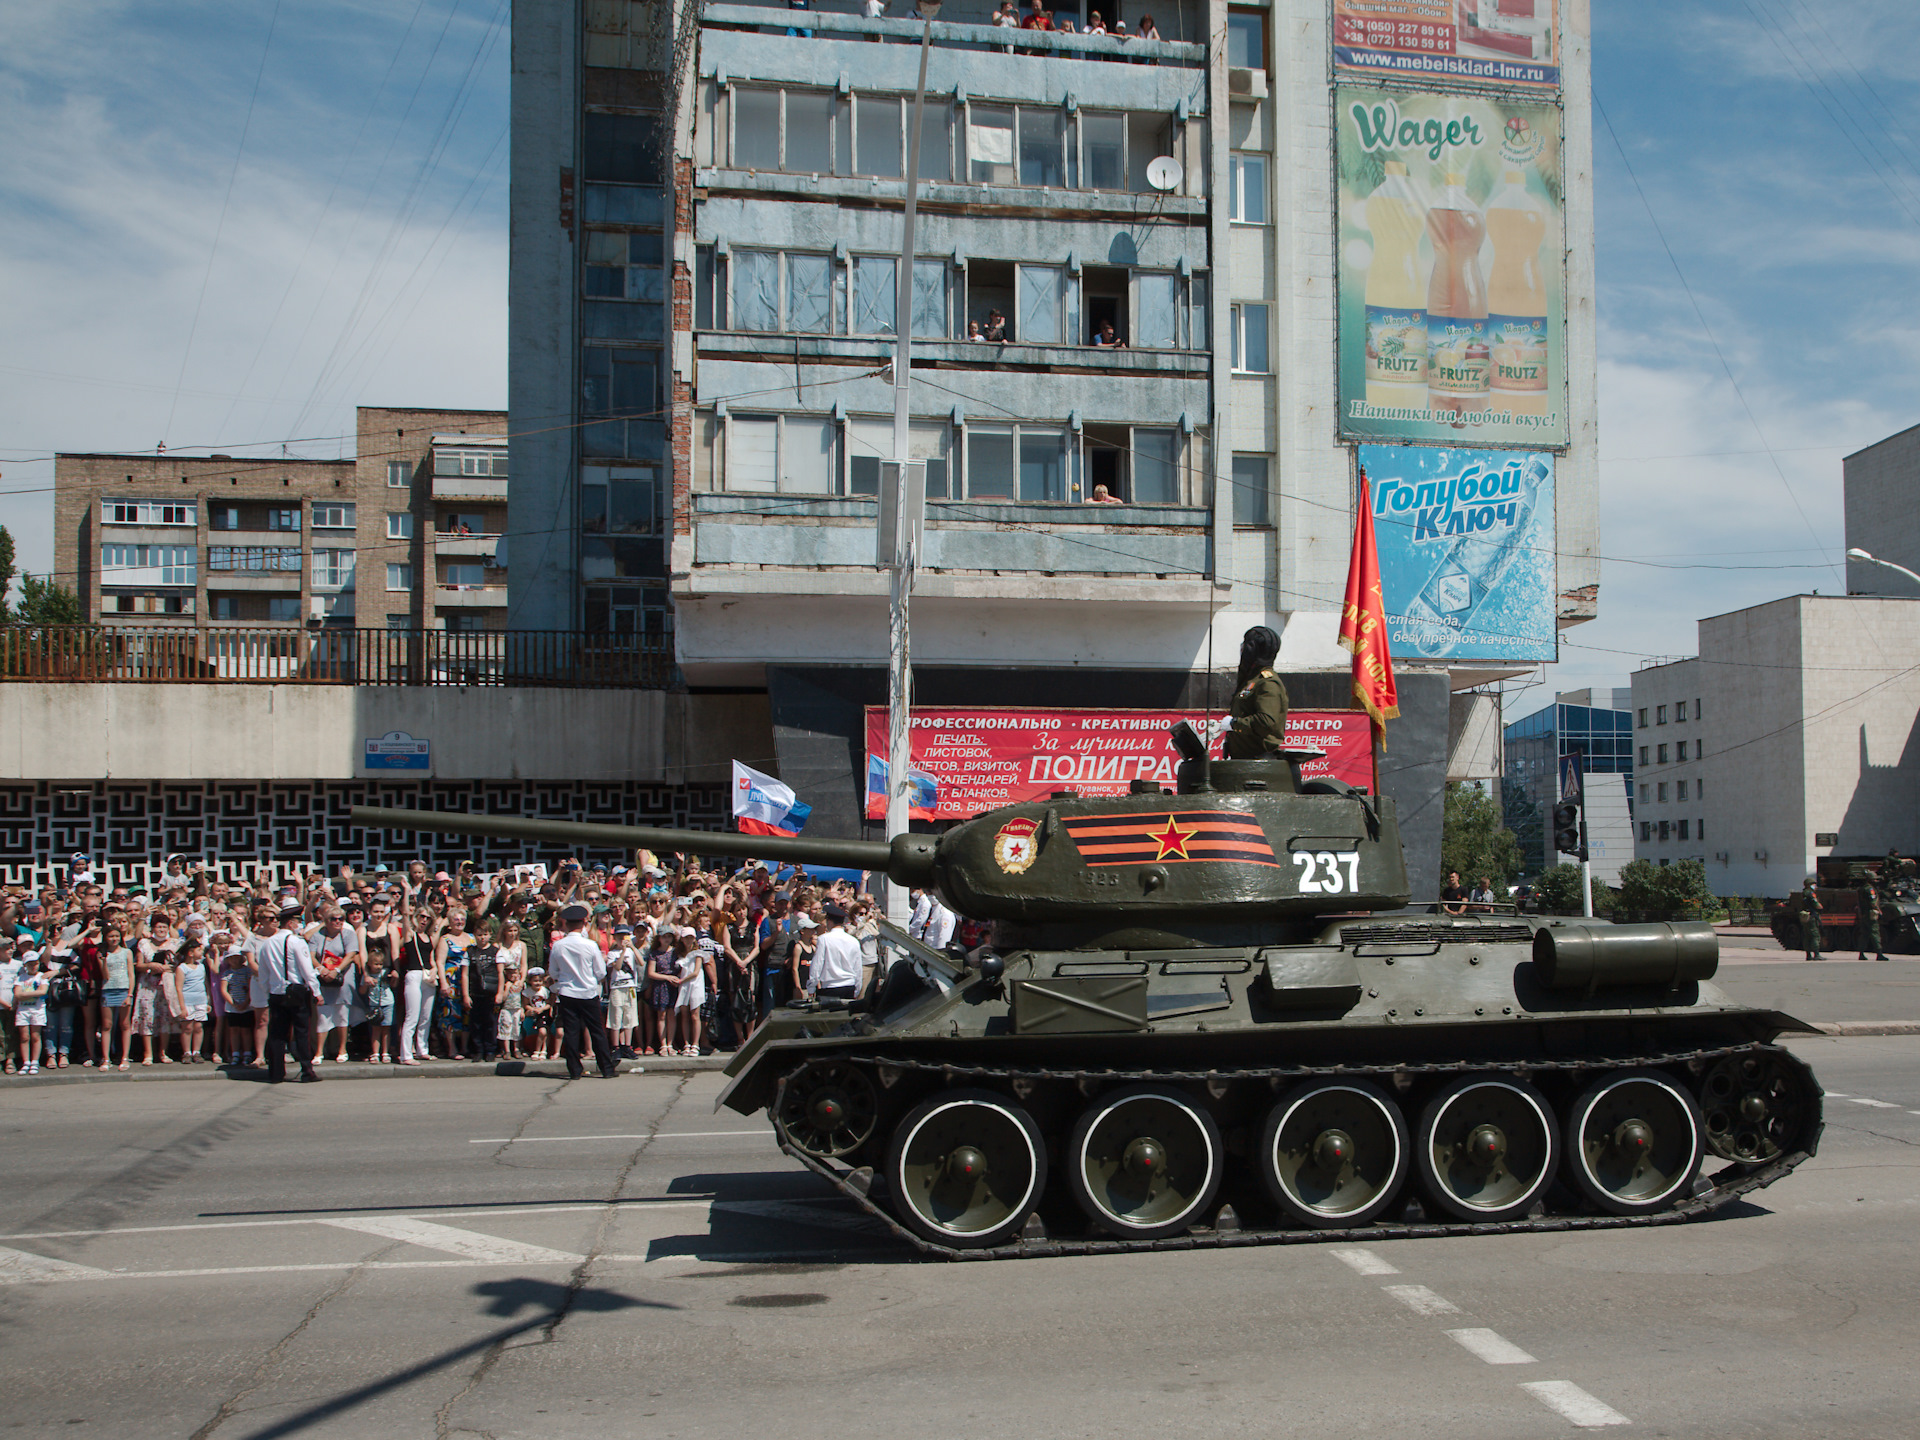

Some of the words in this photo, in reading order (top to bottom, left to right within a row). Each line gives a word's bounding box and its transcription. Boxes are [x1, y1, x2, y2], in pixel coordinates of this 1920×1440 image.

[1344, 2, 1386, 12] бывший
[1389, 5, 1410, 14] маг.
[1412, 7, 1447, 17] «Обои»
[1344, 19, 1364, 29] +38
[1367, 21, 1395, 34] (050)
[1398, 23, 1418, 34] 227
[1421, 25, 1434, 36] 89
[1437, 27, 1449, 37] 01
[1344, 32, 1364, 42] +38
[1367, 33, 1395, 47] (072)
[1398, 36, 1418, 47] 130
[1421, 38, 1434, 49] 59
[1437, 40, 1449, 50] 61
[1350, 51, 1544, 81] www.mebelsklad-lnr.ru
[1352, 101, 1485, 161] Wager
[1377, 356, 1418, 372] FRUTZ
[1440, 366, 1480, 381] FRUTZ
[1499, 365, 1538, 379] FRUTZ
[1351, 400, 1432, 421] Напитки
[1435, 410, 1457, 422] на
[1458, 408, 1511, 425] любой
[1515, 413, 1556, 431] вкус!
[1375, 461, 1524, 524] Голубой
[1414, 503, 1517, 541] Ключ
[1427, 614, 1461, 628] вода,
[1393, 631, 1477, 645] безупречное
[1480, 633, 1549, 646] качество!
[1081, 718, 1171, 730] КРЕАТИВНО
[1285, 720, 1343, 730] БЫСТРО
[933, 734, 987, 746] ПЕЧАТЬ:
[1032, 732, 1060, 750] За
[1070, 737, 1155, 755] лучшим
[1283, 735, 1342, 746] ОВЛЕНИЕ:
[923, 747, 992, 759] ЛИСТОВОК,
[963, 761, 1022, 773] ВИЗИТОК,
[938, 773, 1020, 786] КАЛЕНДАРЕЙ,
[951, 788, 1010, 799] БЛАНКОВ,
[1075, 784, 1113, 794] Луганск,
[1117, 785, 1130, 793] ул.
[1291, 850, 1360, 894] 237
